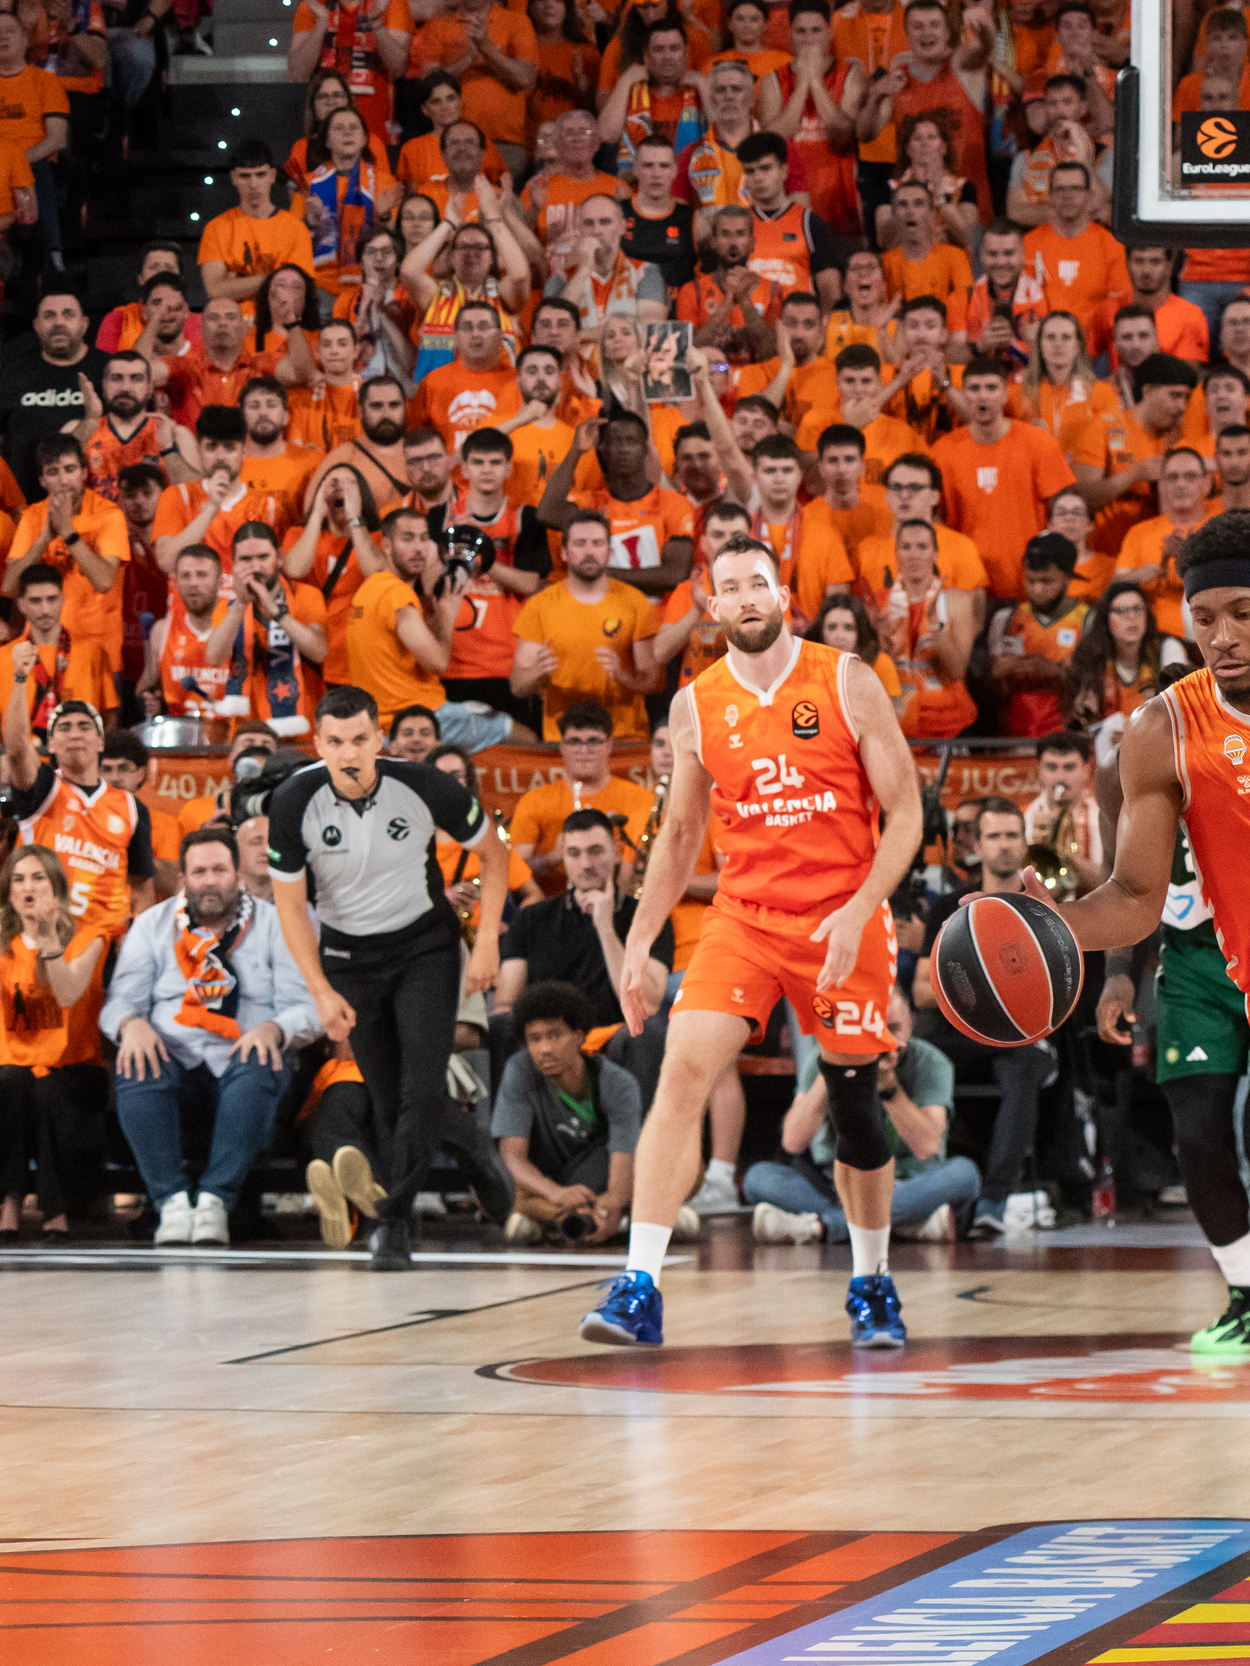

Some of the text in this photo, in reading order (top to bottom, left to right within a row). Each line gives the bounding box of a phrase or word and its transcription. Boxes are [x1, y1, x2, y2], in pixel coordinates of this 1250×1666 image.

[21, 388, 85, 406] adida
[157, 773, 197, 800] 40
[751, 754, 805, 795] 24
[736, 791, 837, 818] VALENCIA
[765, 811, 813, 827] BASKET
[836, 1000, 884, 1039] 24
[949, 1526, 1244, 1589] BASKET
